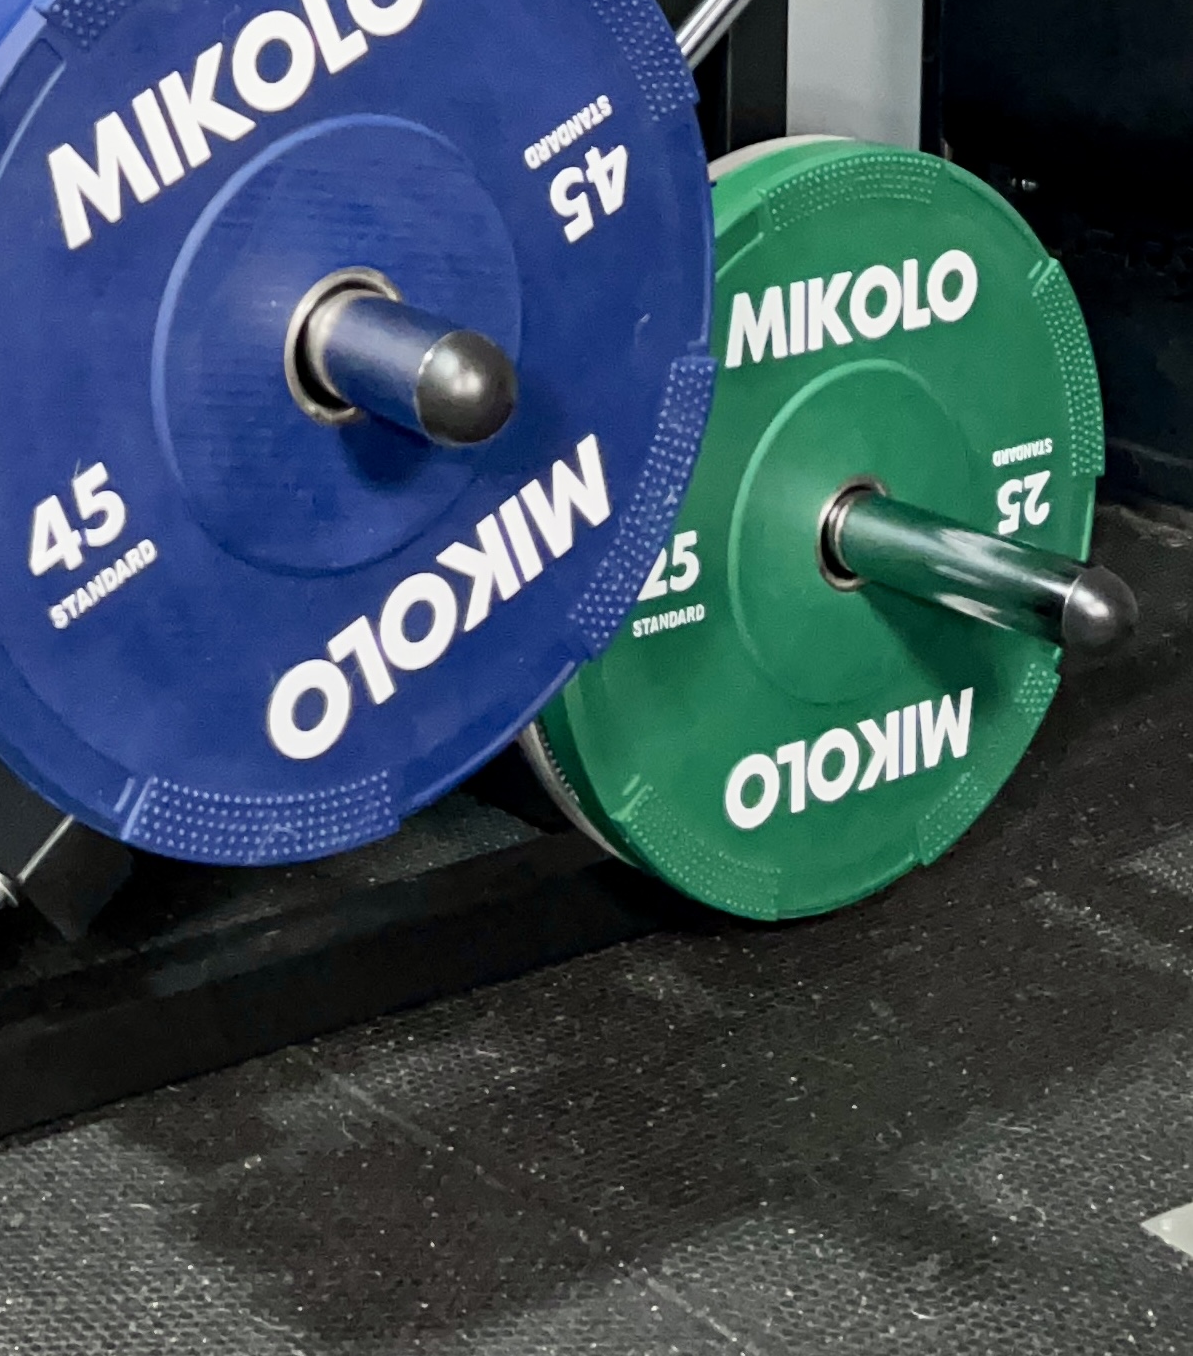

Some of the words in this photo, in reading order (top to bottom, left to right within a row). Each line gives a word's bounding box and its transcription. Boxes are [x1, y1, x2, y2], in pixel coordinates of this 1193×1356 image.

[523, 94, 613, 170] STANDARD
[549, 145, 629, 243] 45
[725, 249, 979, 369] MIKOLO
[992, 438, 1054, 467] STANDARD
[29, 462, 126, 578] 45
[996, 470, 1052, 536] 25
[49, 538, 159, 631] STANDARD
[267, 433, 611, 761] MIKOLO
[633, 604, 705, 638] STANDARD
[725, 687, 974, 830] MIKOLO
